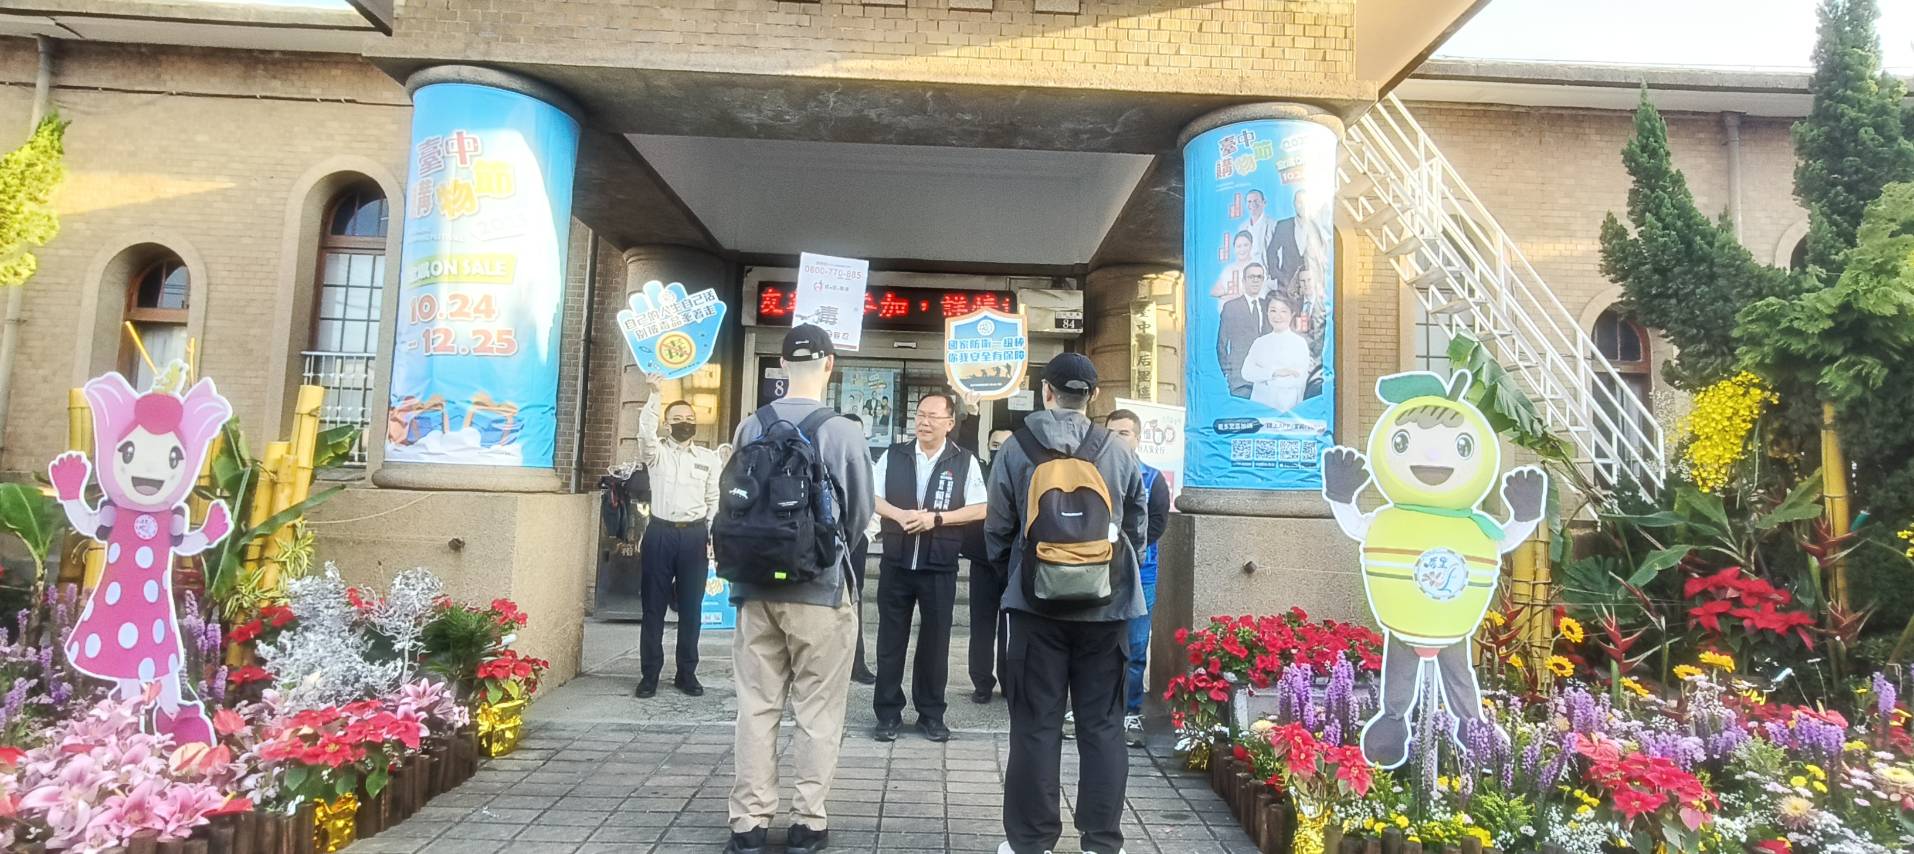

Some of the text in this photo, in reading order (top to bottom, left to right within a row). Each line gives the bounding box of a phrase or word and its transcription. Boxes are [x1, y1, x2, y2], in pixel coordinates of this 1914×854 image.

[417, 129, 481, 178] 臺中
[409, 292, 499, 324] 10.24
[1062, 319, 1075, 329] 84
[948, 337, 1025, 350] 國家防衛一級棒
[948, 350, 1025, 363] 你我安全有保障
